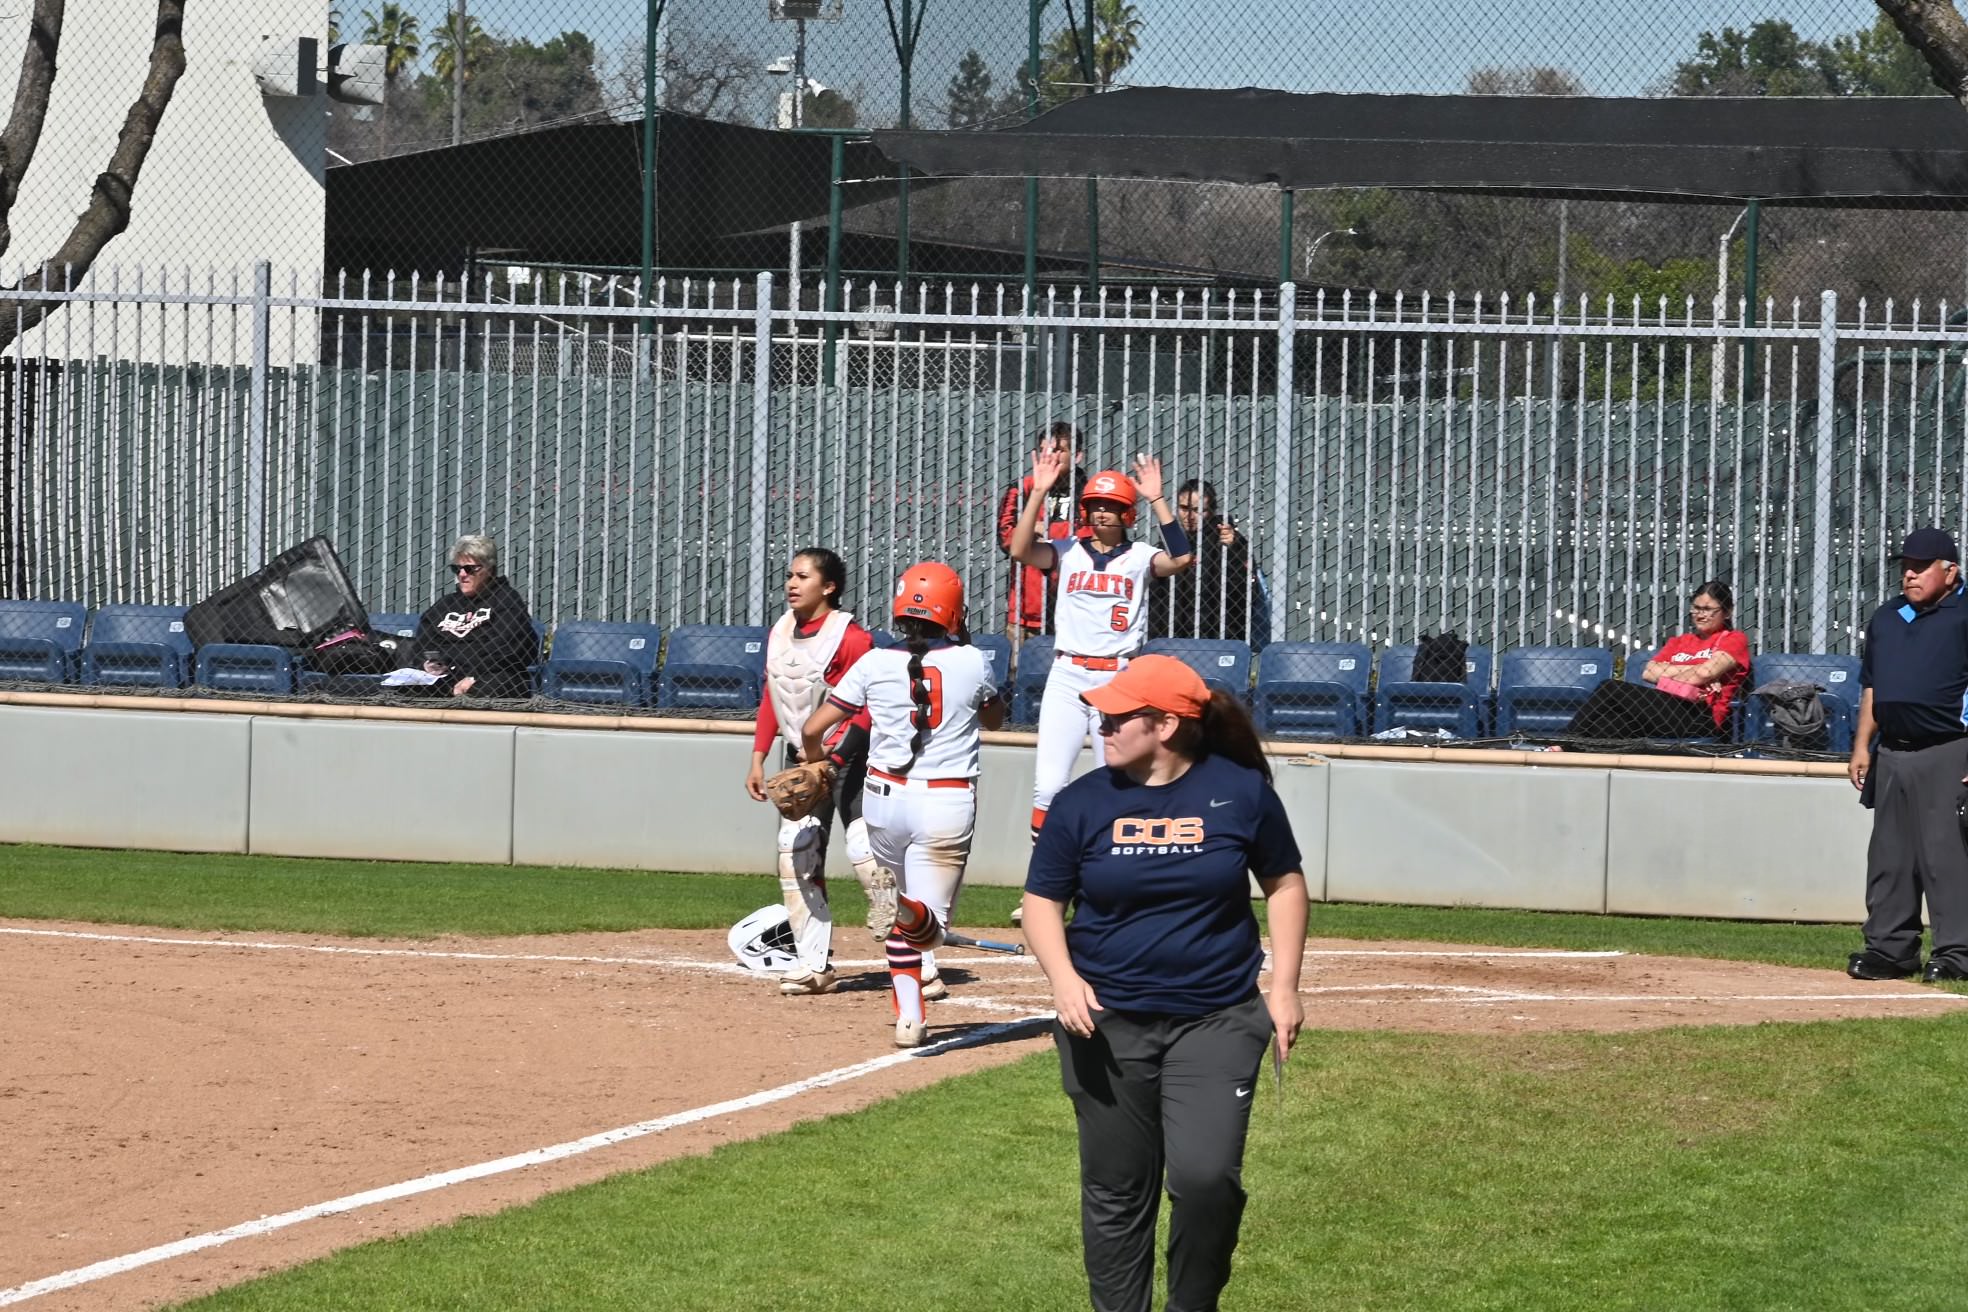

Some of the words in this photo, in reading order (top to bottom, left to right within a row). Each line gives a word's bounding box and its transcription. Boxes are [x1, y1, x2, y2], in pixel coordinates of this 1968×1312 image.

[1067, 571, 1133, 600] GIANTS
[1111, 605, 1129, 632] 5
[1112, 817, 1204, 845] COS
[1111, 845, 1203, 855] SOFTBALL
